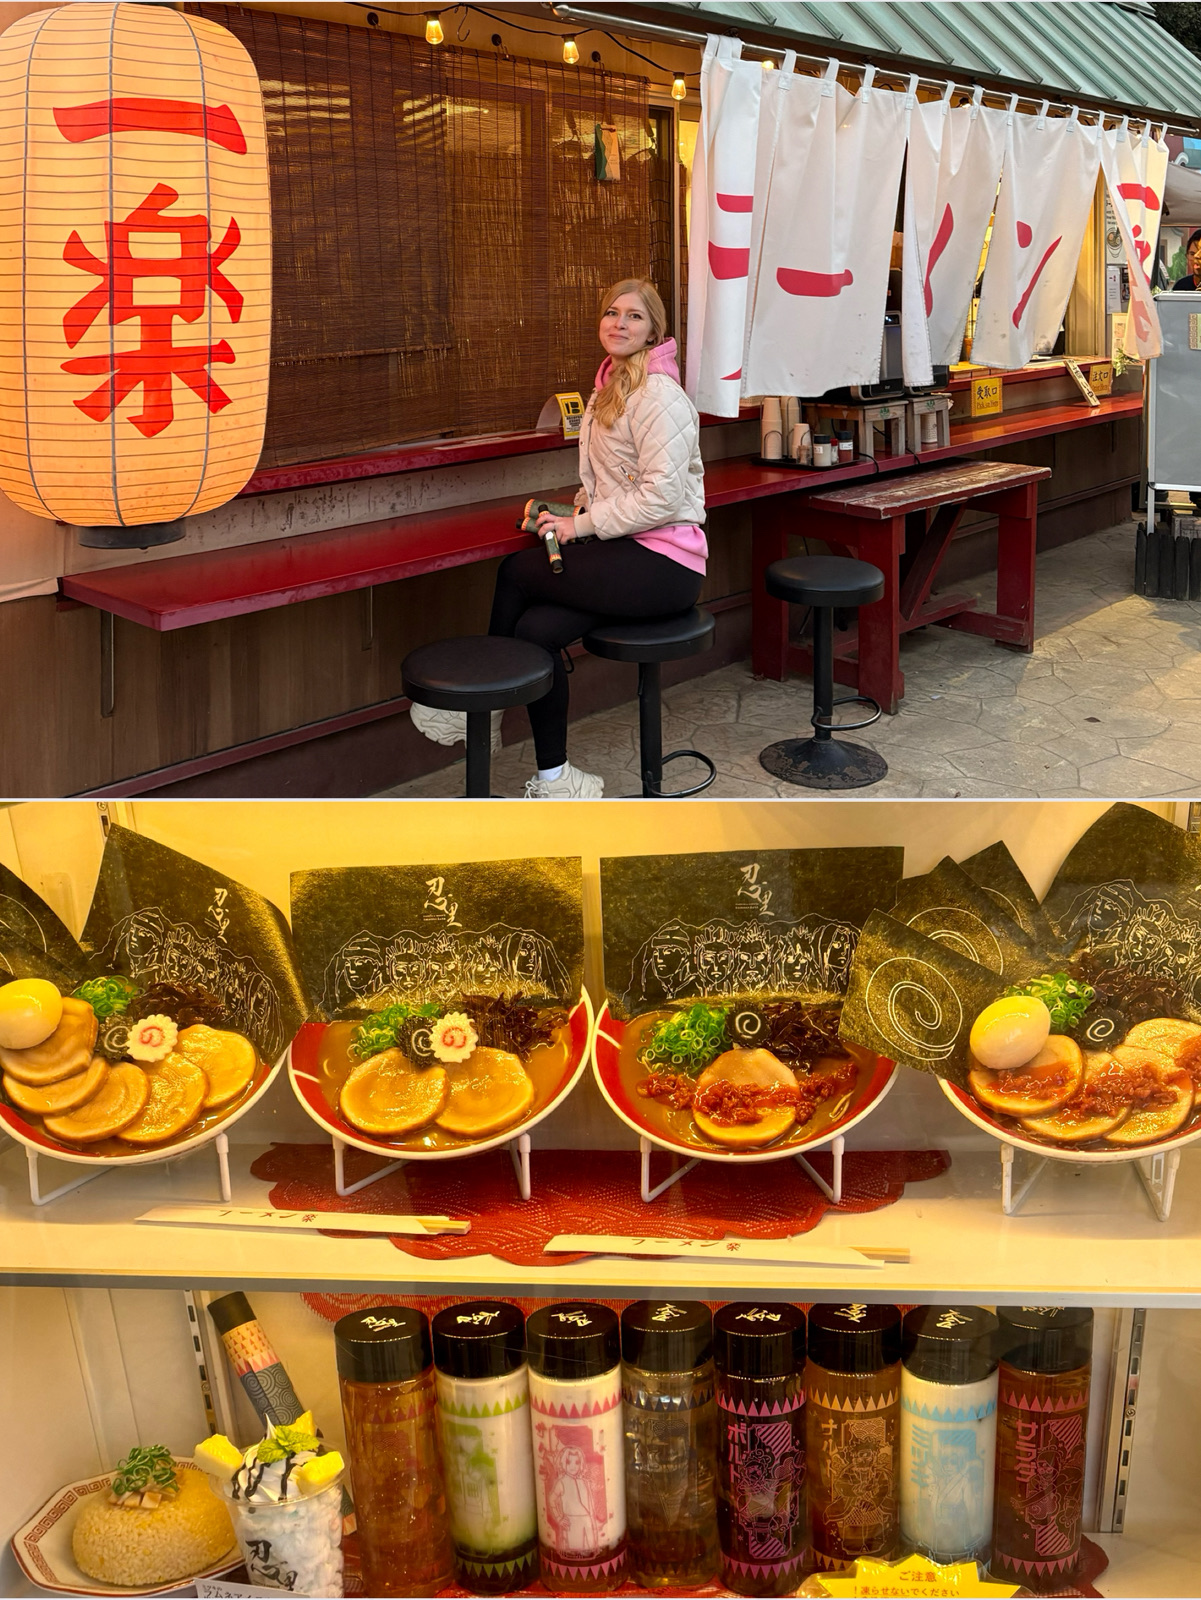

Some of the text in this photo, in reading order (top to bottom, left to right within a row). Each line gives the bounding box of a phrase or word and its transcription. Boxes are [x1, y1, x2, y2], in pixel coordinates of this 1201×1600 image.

[53, 98, 247, 438] 一楽
[976, 385, 998, 400] 受取口
[728, 1422, 747, 1482] ボルト
[1014, 1419, 1038, 1482] サラダ
[899, 1571, 937, 1582] ご注意
